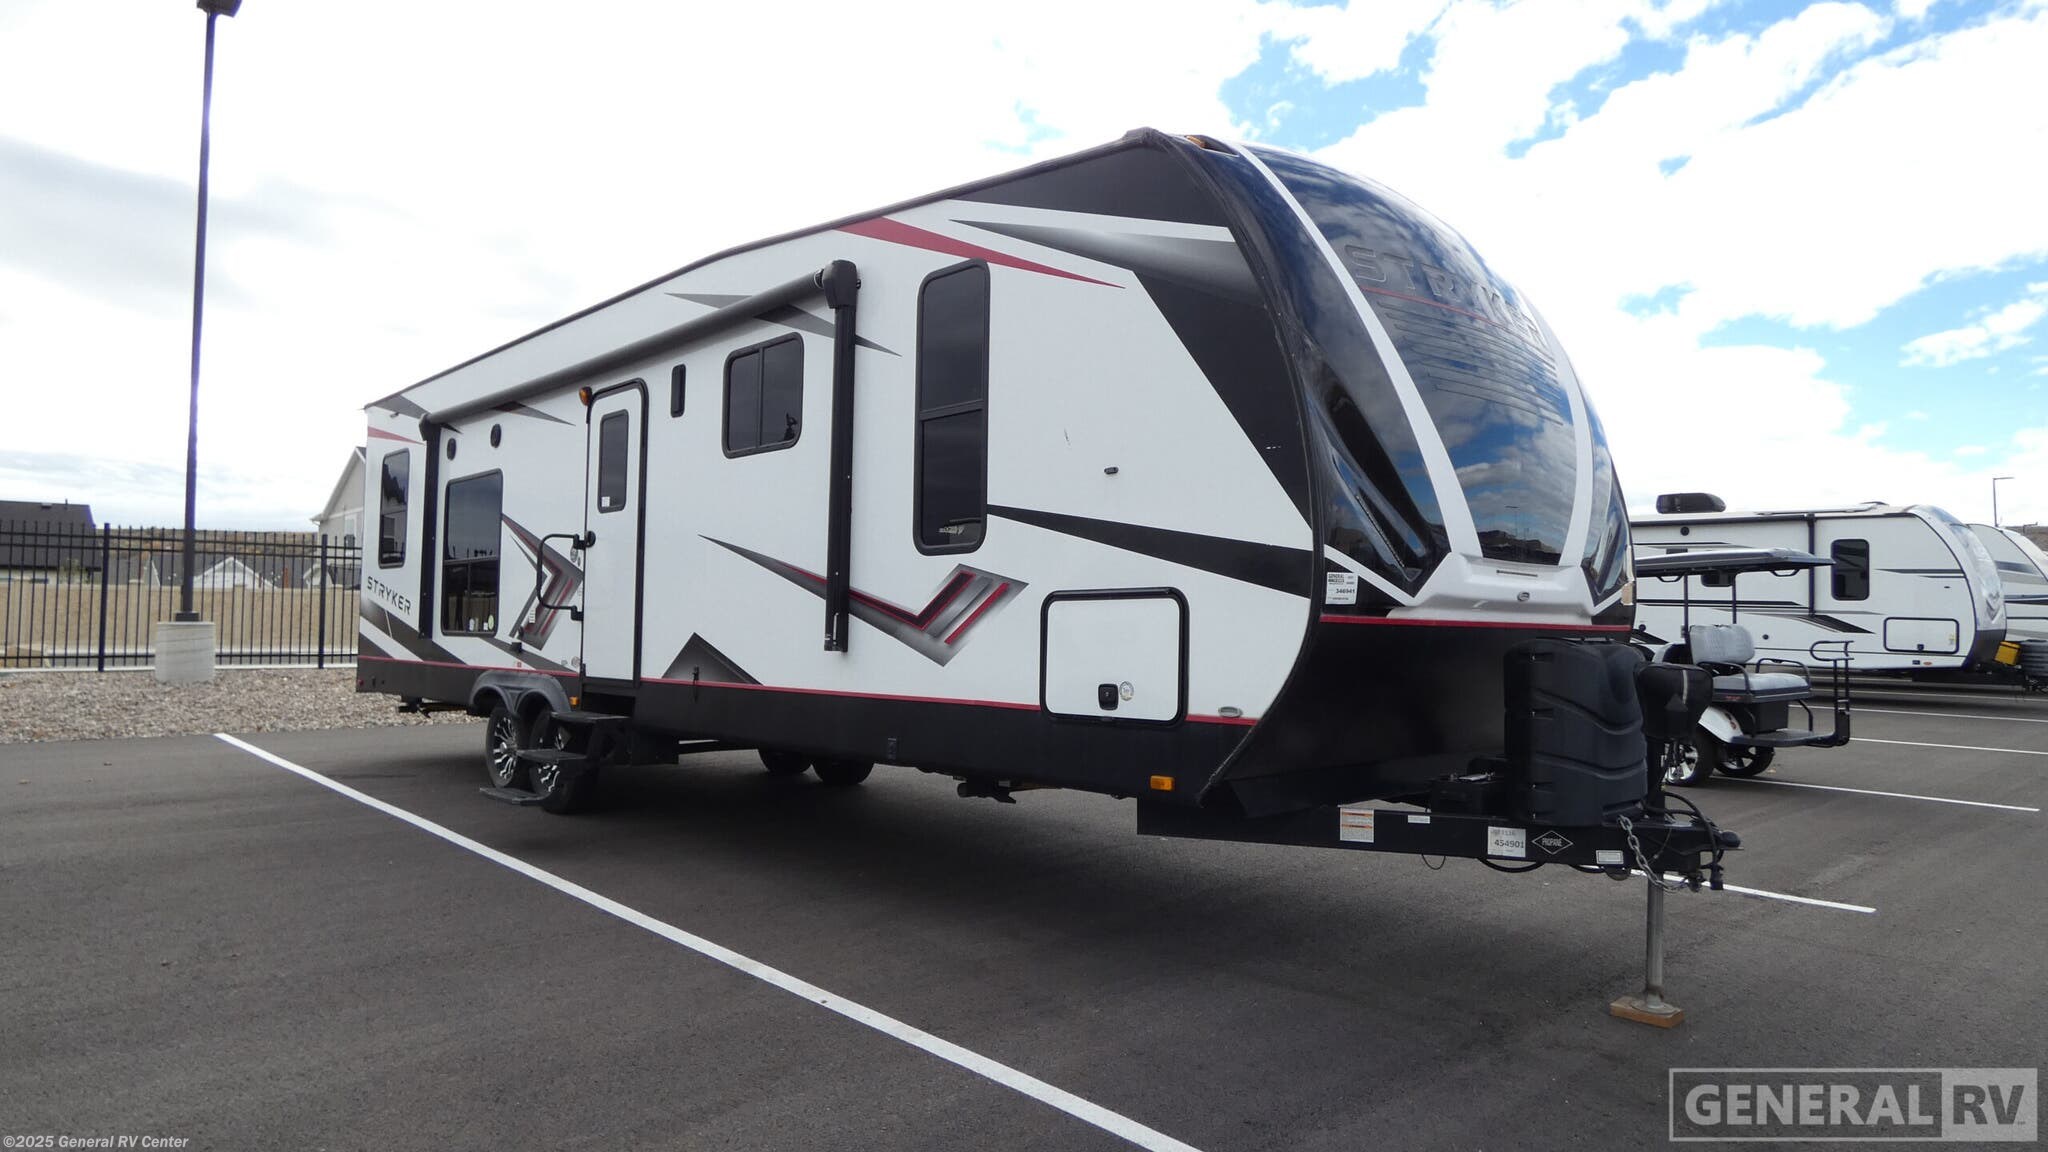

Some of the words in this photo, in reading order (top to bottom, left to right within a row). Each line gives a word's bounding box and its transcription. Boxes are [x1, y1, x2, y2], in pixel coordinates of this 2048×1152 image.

[368, 576, 411, 615] STRYKER
[1494, 839, 1524, 848] 454901
[1541, 837, 1563, 847] PROPANE
